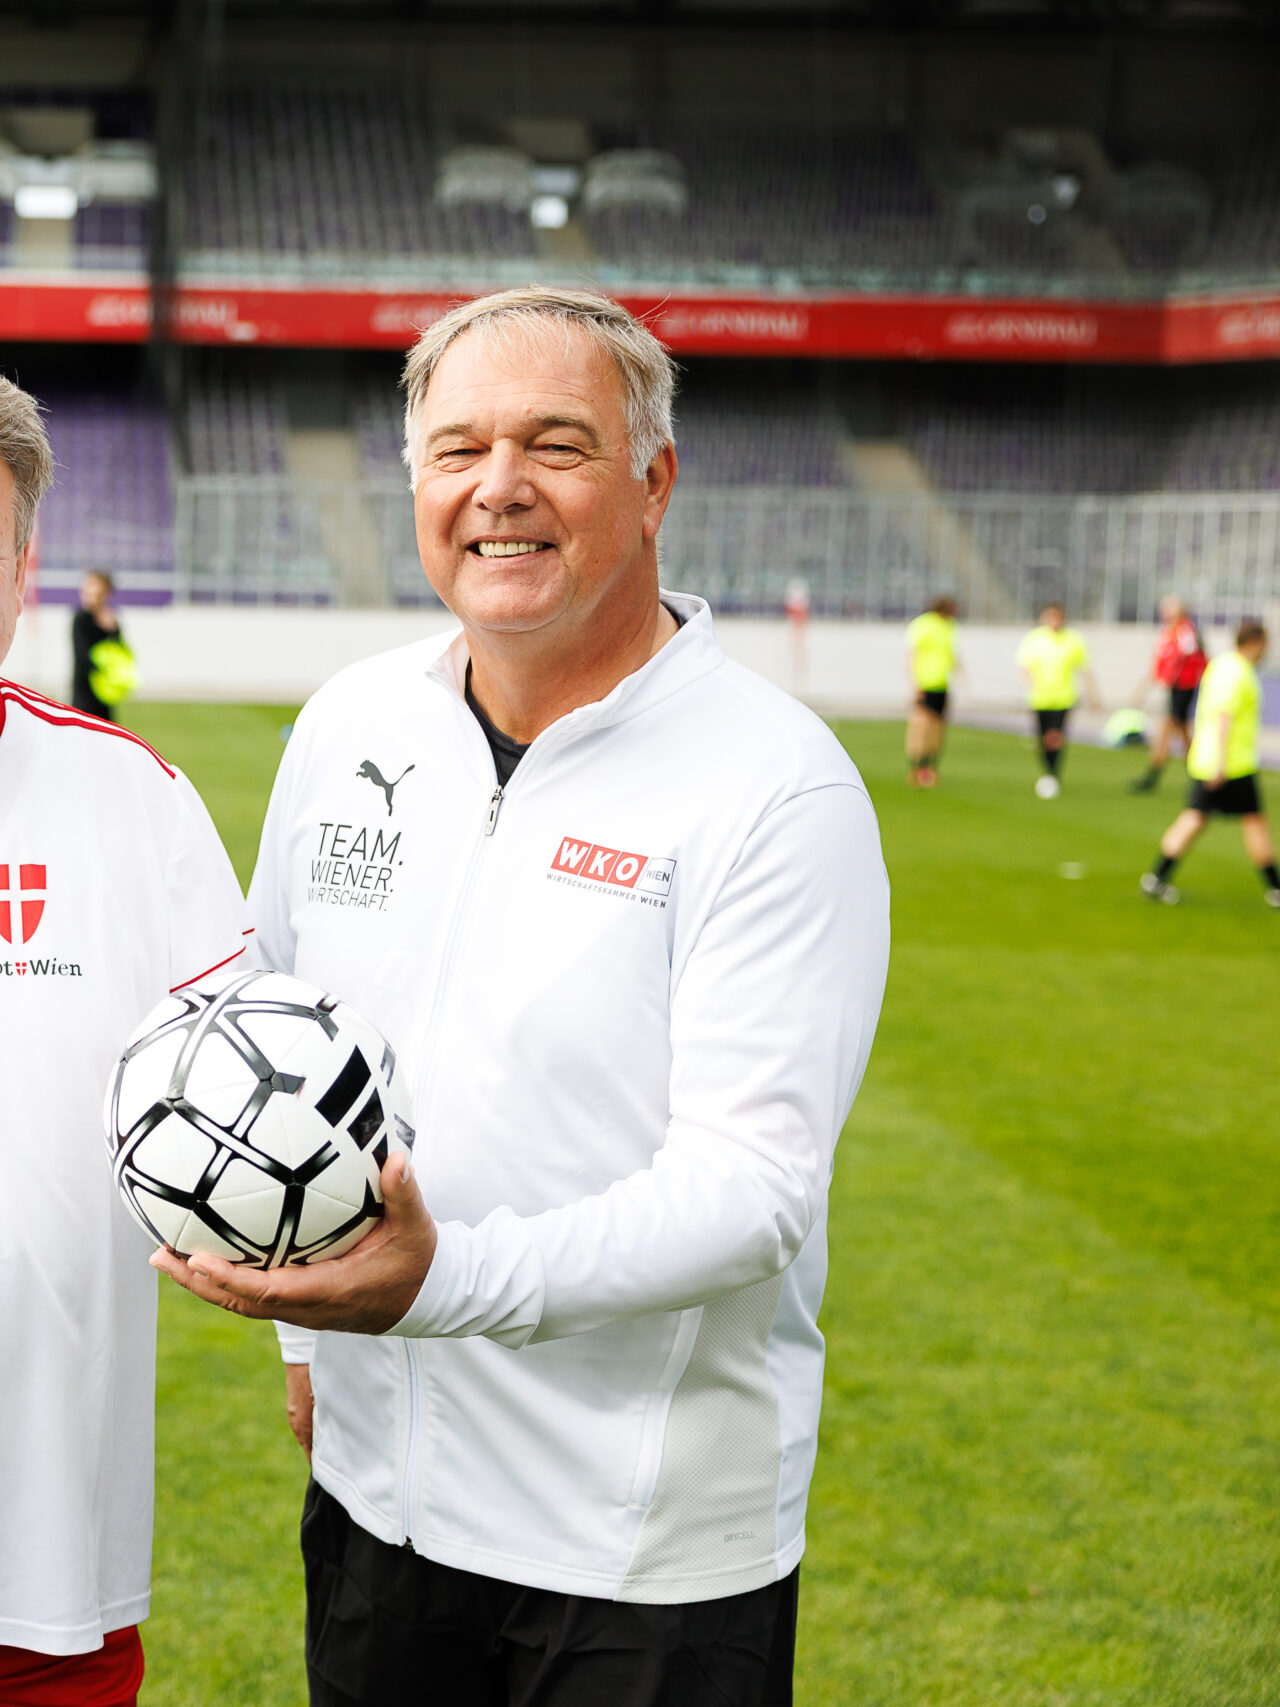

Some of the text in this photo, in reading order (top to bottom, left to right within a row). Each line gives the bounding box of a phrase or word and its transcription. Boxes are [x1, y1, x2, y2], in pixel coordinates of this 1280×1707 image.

[318, 822, 403, 866] TEAM.
[311, 859, 394, 893] WIENER.
[559, 841, 671, 883] WKO WIEN
[307, 886, 389, 912] WRTSCHAFT.
[546, 872, 667, 909] WIRTSCHAFTSKAMMER WIEN
[29, 957, 83, 977] Wien
